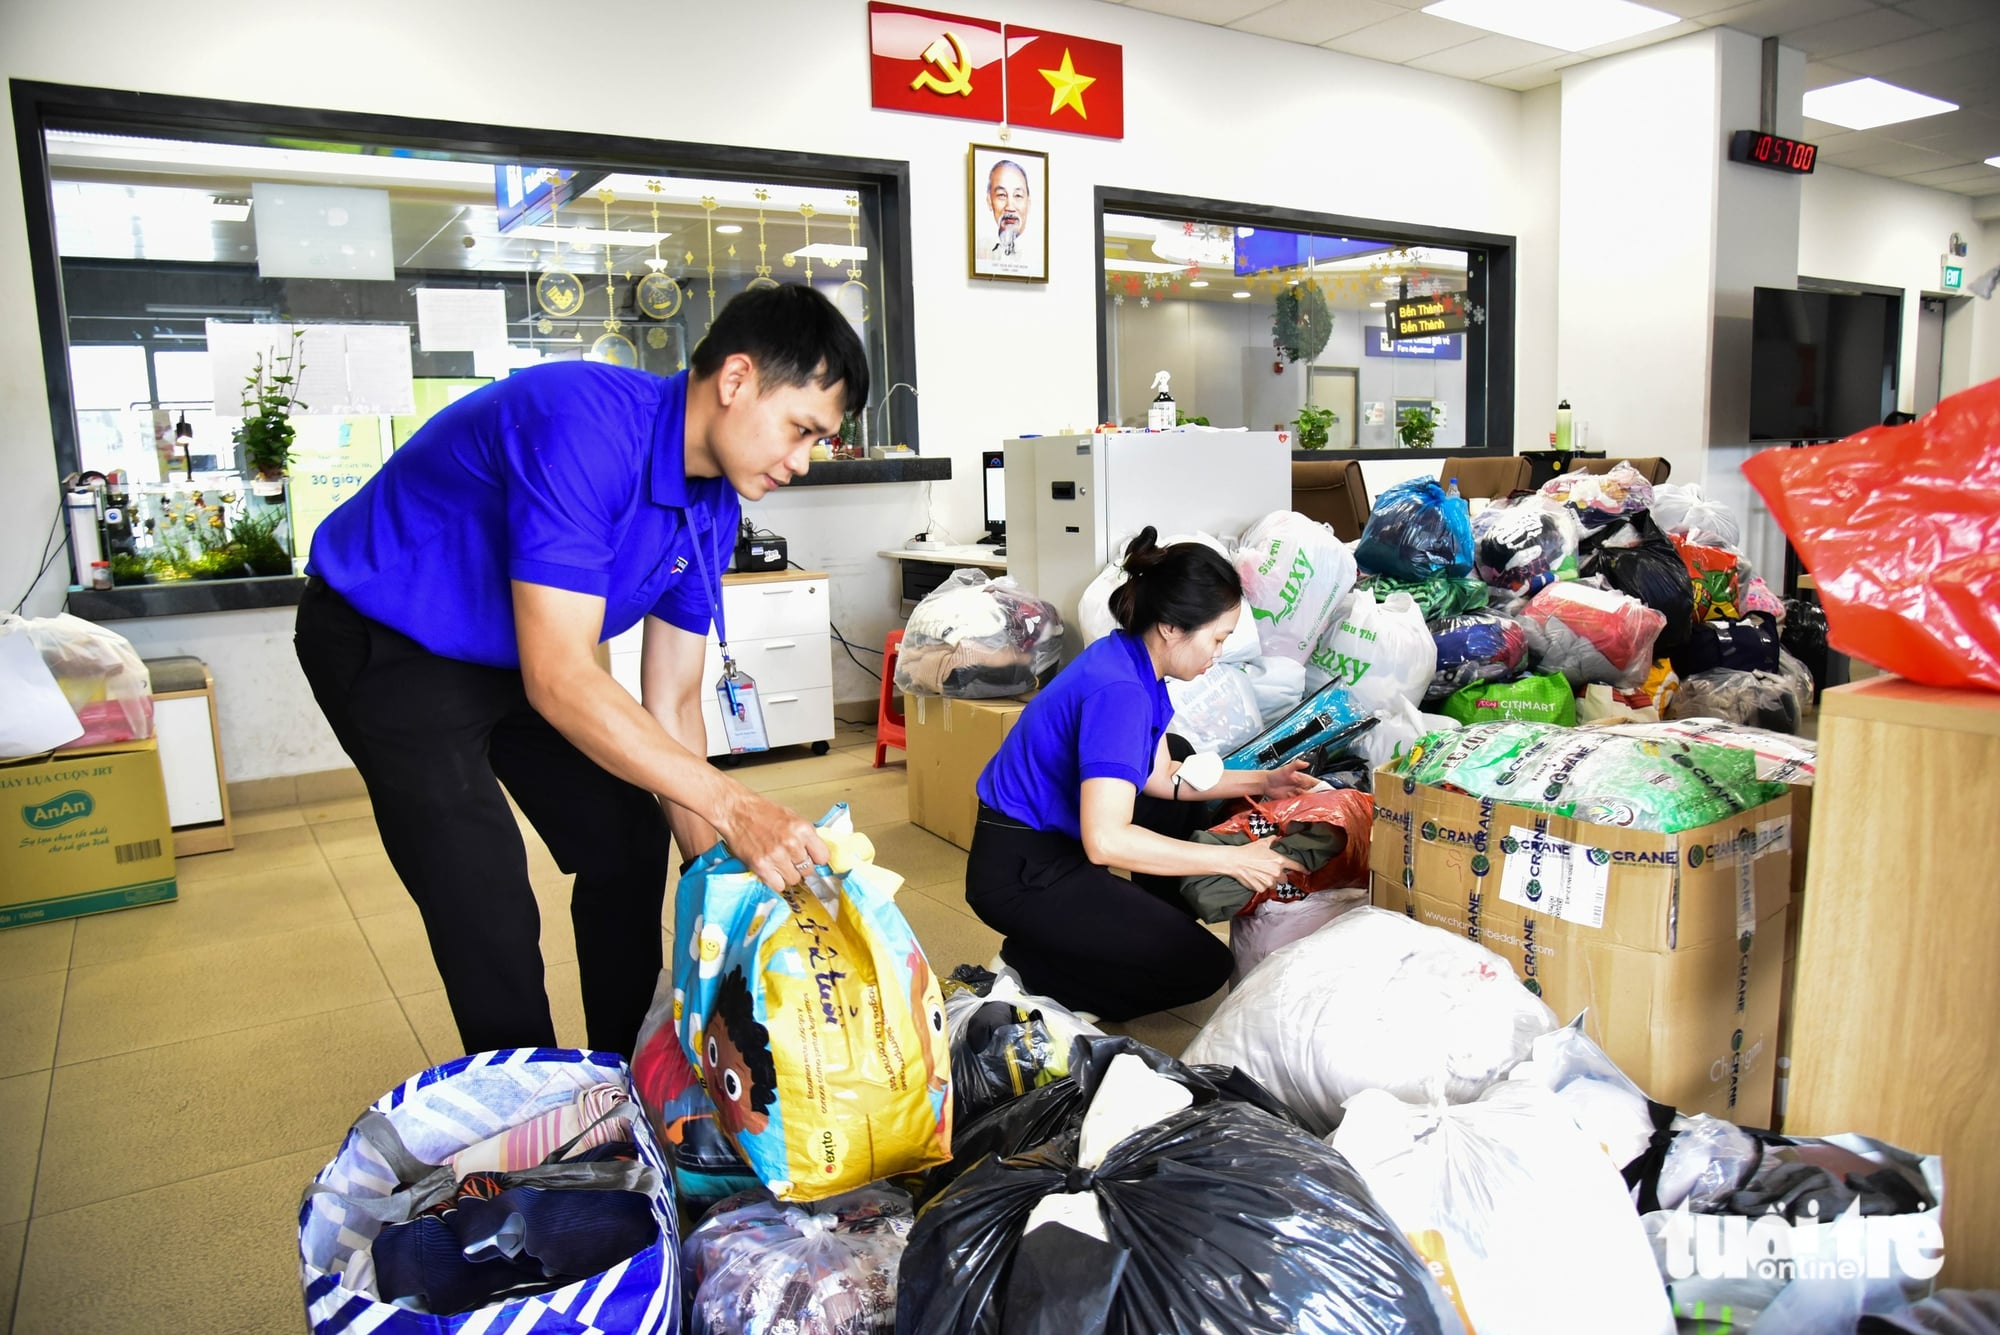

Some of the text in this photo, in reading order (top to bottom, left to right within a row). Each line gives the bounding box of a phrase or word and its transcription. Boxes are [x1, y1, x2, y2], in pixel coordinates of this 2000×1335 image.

[1390, 312, 1396, 329] 1
[311, 474, 328, 486] 30
[1250, 547, 1315, 628] Luxy
[1500, 700, 1555, 712] CITIMART
[33, 801, 86, 823] AnAn
[1611, 851, 1678, 865] CRANE
[1525, 916, 1538, 977] CRANE
[822, 1131, 838, 1163] éxito
